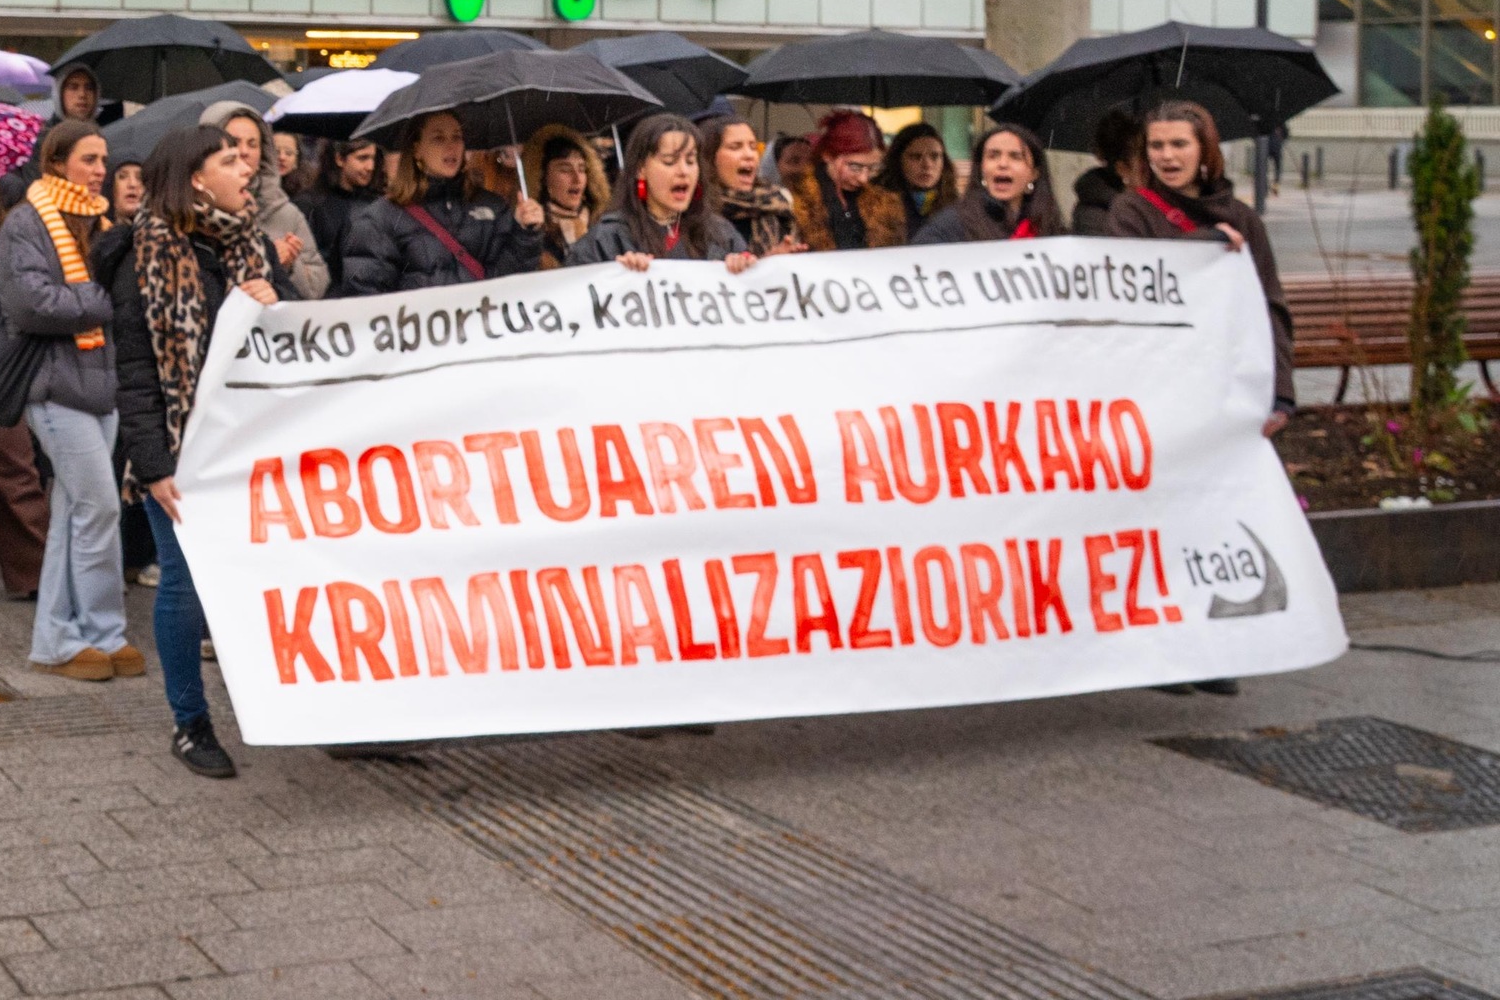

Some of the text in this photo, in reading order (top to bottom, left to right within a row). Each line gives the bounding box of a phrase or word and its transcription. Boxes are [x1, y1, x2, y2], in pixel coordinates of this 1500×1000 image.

[371, 295, 580, 353] abortua,
[588, 270, 882, 329] kalitatezkoa
[890, 263, 966, 310] eta
[974, 254, 1185, 307] unibertsala
[247, 397, 1154, 545] ABORTUAREN AURKAKO
[262, 528, 1184, 685] KRIMINALIZAZIORIK EZ!
[1181, 544, 1261, 589] itaia
